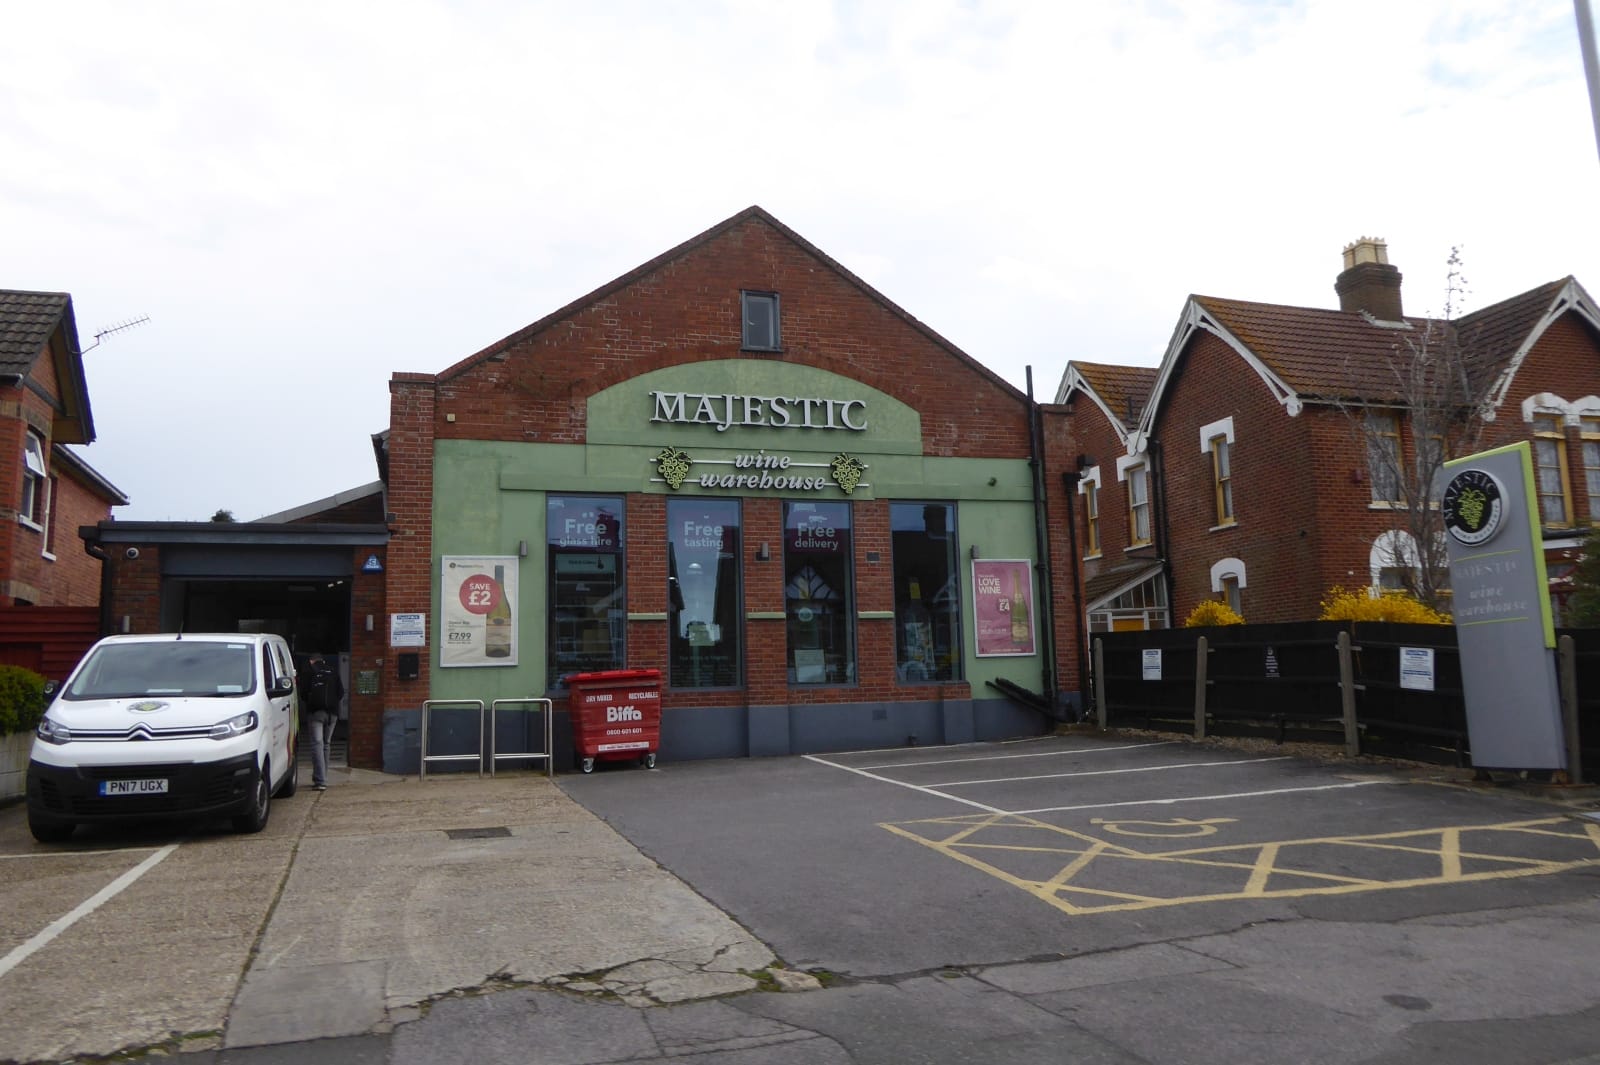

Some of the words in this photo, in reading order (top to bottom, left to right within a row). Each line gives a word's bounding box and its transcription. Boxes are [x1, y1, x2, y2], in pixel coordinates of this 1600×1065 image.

[650, 391, 868, 432] MAJESTIC
[735, 449, 791, 469] wine
[700, 470, 826, 490] warehouse
[1443, 471, 1496, 520] MAJESTIC
[565, 518, 608, 535] Free
[684, 521, 725, 536] Free
[797, 522, 836, 538] Free
[559, 535, 588, 548] glass
[590, 535, 613, 546] hire
[684, 537, 724, 550] tasting
[794, 537, 839, 551] delivery
[978, 577, 1001, 586] LOVE
[978, 586, 1002, 594] WINE
[468, 590, 492, 606] £2
[999, 602, 1010, 611] £4
[448, 632, 472, 640] £7.99
[606, 705, 643, 723] Biffa
[110, 781, 137, 793] PN17
[140, 780, 164, 792] UGX
